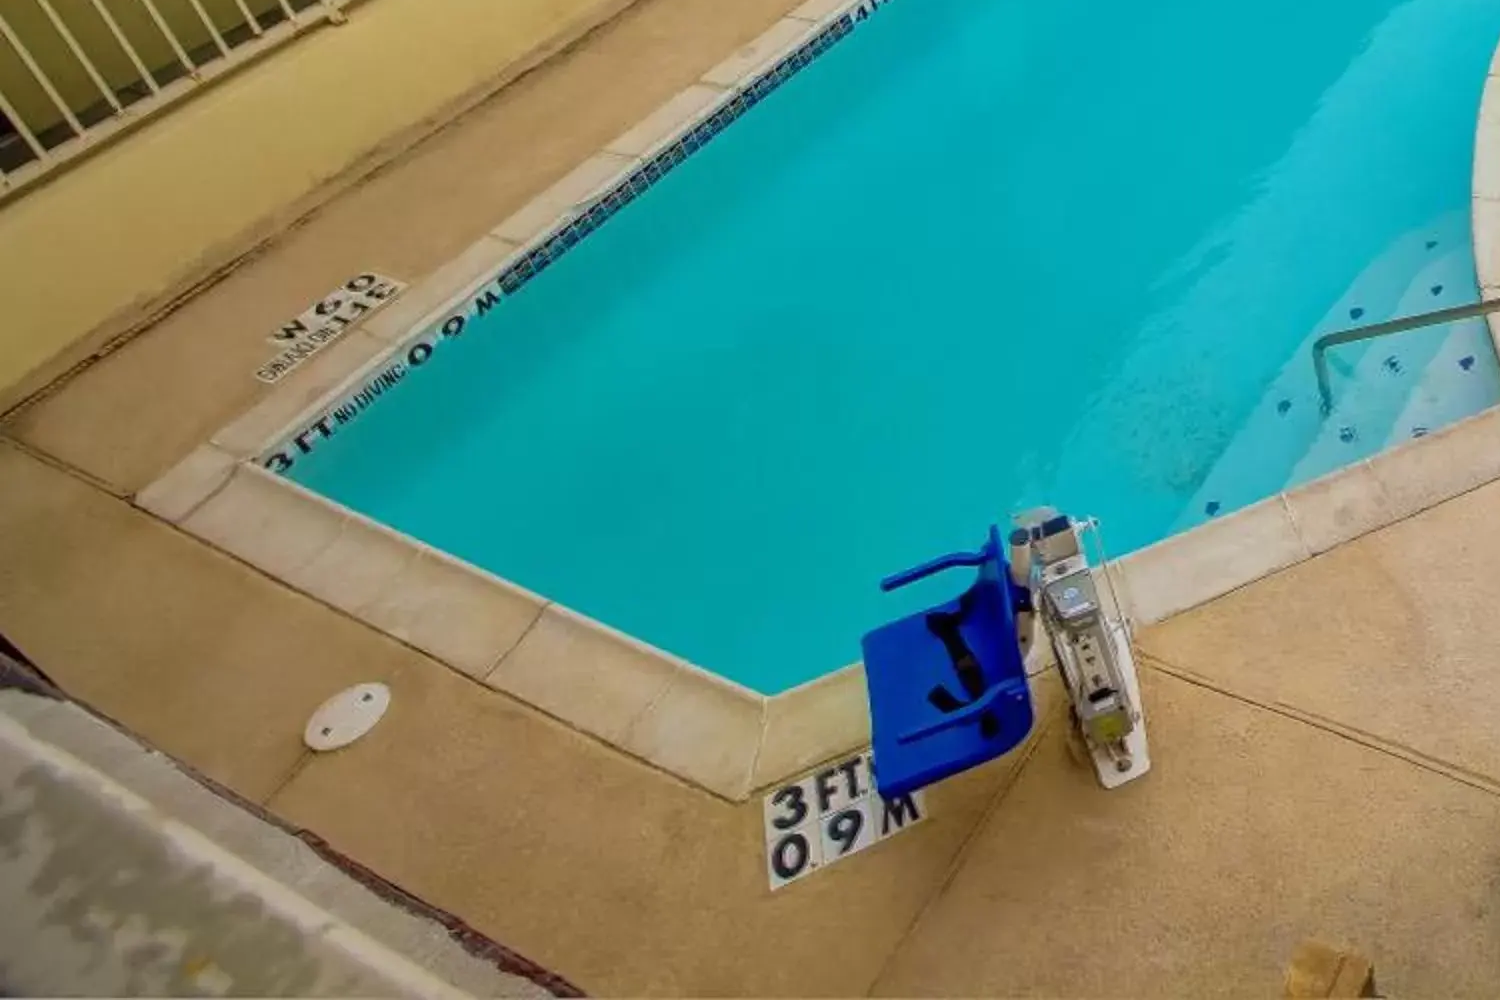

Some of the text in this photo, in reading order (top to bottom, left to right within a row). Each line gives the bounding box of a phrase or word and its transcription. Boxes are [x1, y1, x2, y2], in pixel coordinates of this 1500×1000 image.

[264, 452, 295, 474] 3
[333, 403, 358, 425] NO
[475, 290, 502, 318] M
[771, 785, 808, 830] 3
[828, 809, 865, 855] 9
